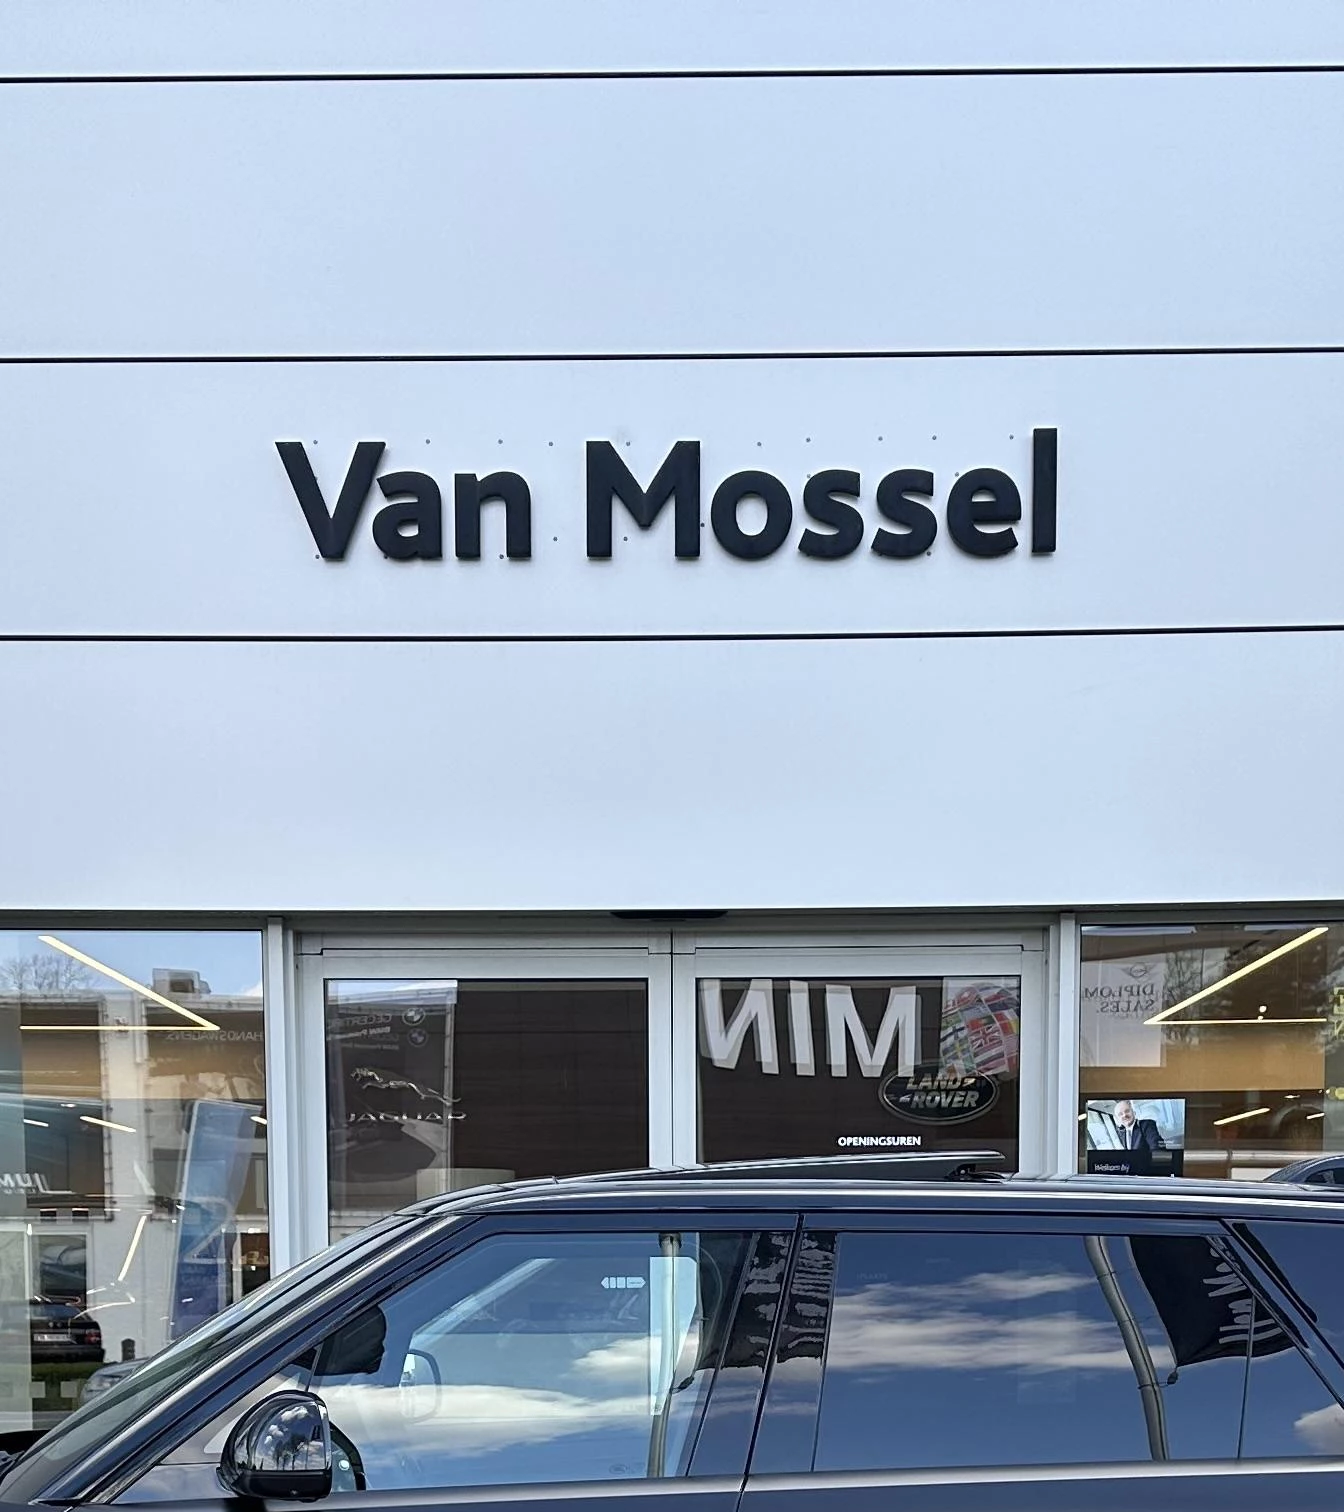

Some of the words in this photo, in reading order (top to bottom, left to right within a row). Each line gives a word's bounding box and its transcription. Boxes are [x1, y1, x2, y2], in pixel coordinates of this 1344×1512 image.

[275, 441, 532, 561] Van
[586, 428, 1058, 560] Mossel
[906, 1073, 961, 1090] LAND
[910, 1090, 979, 1109] ROVER
[837, 1136, 921, 1146] OPENINGSUREN
